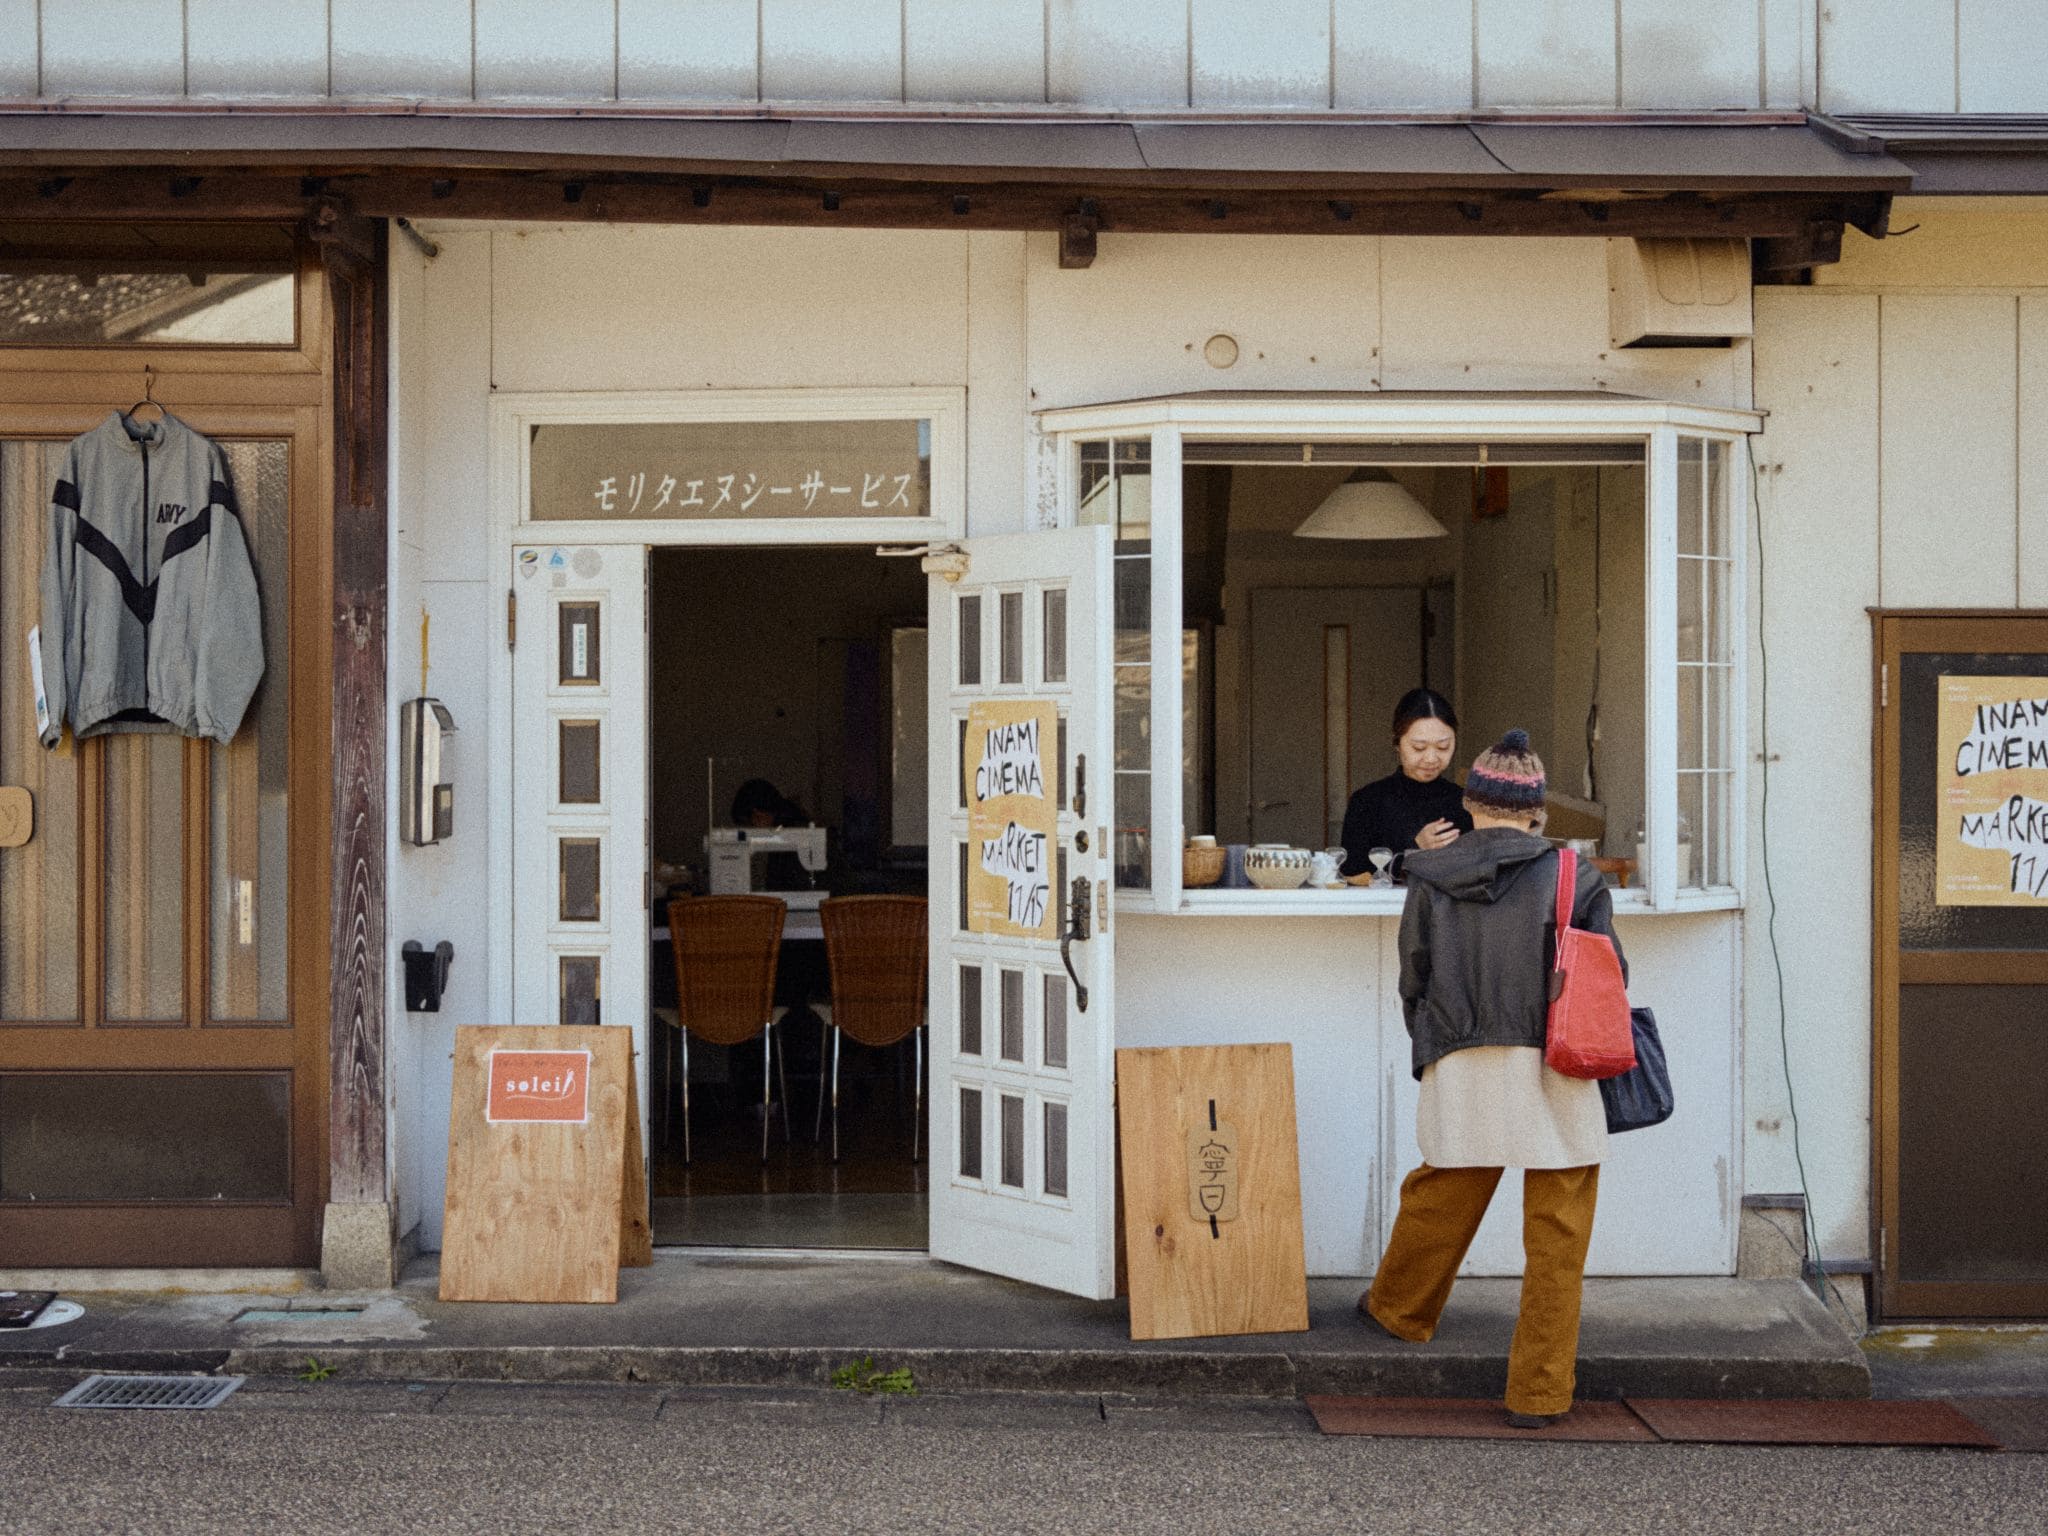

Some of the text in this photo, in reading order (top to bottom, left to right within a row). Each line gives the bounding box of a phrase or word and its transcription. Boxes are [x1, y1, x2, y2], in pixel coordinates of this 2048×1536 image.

[595, 470, 911, 513] モリタエヌシーサービス
[986, 717, 1040, 760] INAMI
[975, 759, 1045, 802] CINEMA
[981, 820, 1047, 874] MARKET
[1007, 880, 1050, 929] 11/15
